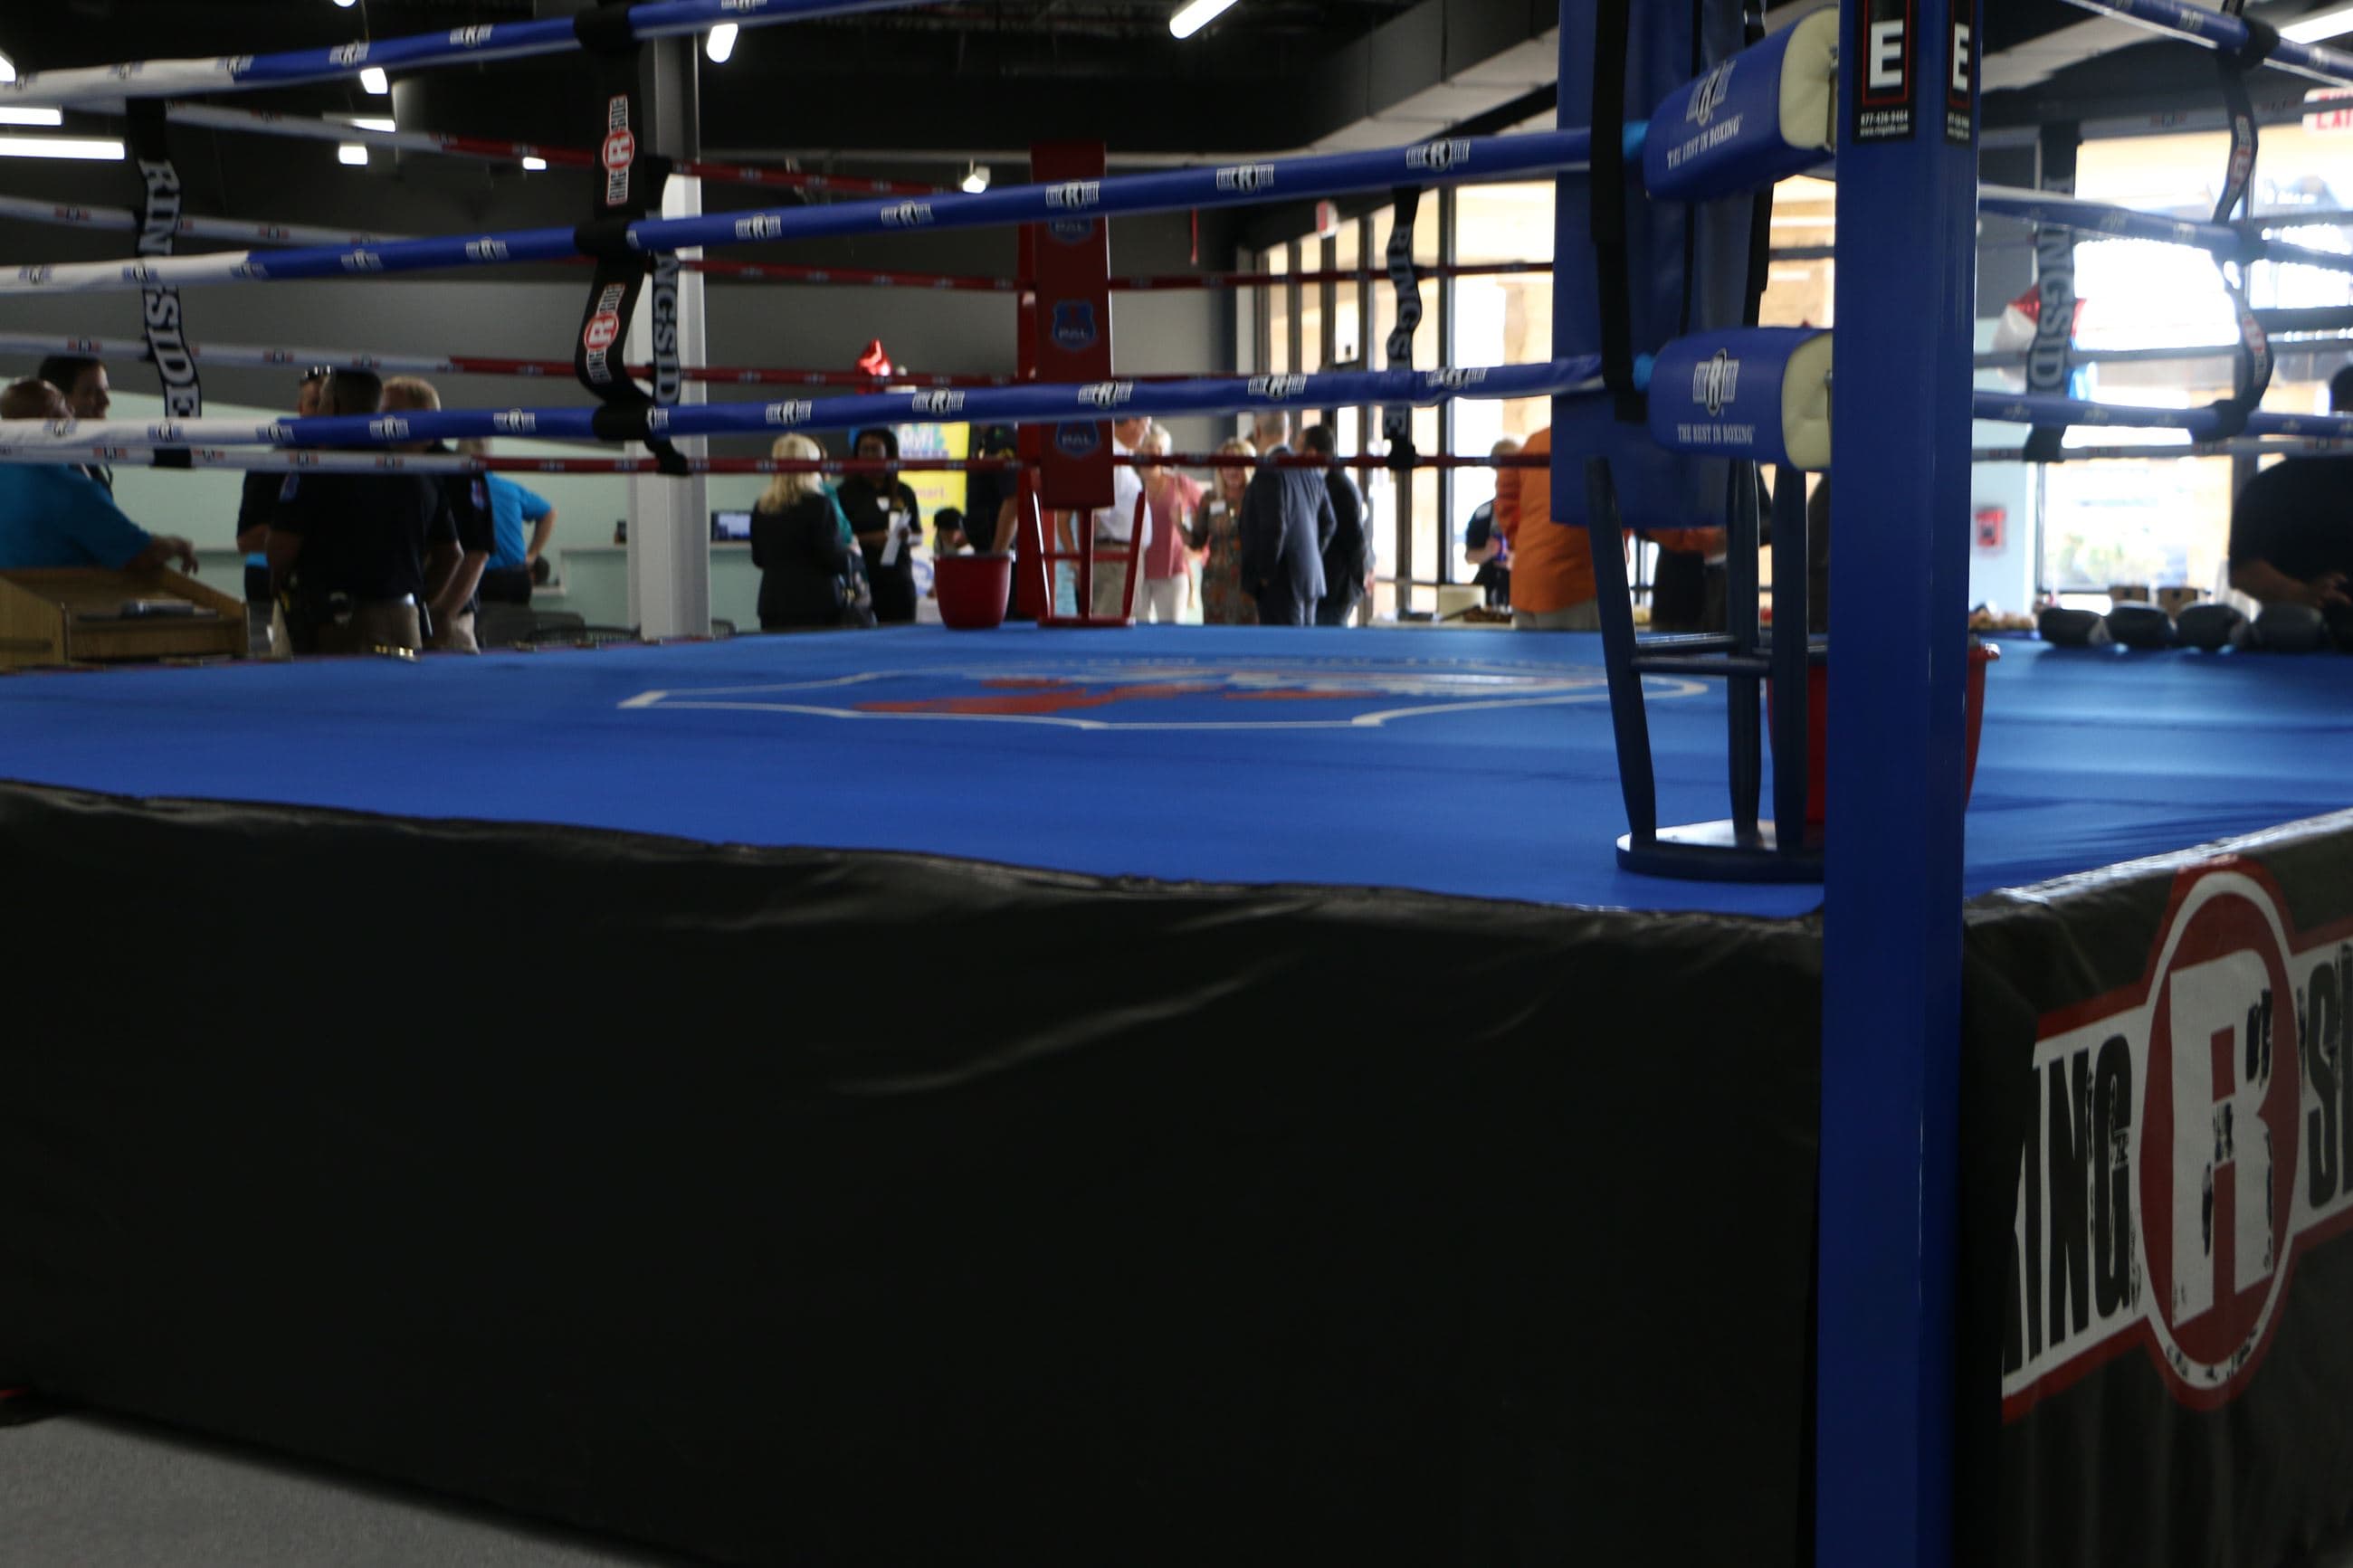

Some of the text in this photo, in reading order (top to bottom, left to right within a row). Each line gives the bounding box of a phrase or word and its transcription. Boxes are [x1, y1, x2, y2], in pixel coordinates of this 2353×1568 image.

[1870, 19, 1903, 89] E
[1953, 22, 1970, 91] E
[138, 158, 201, 419] RINSIDE
[2002, 1034, 2131, 1377] ING
[2169, 949, 2274, 1329] R
